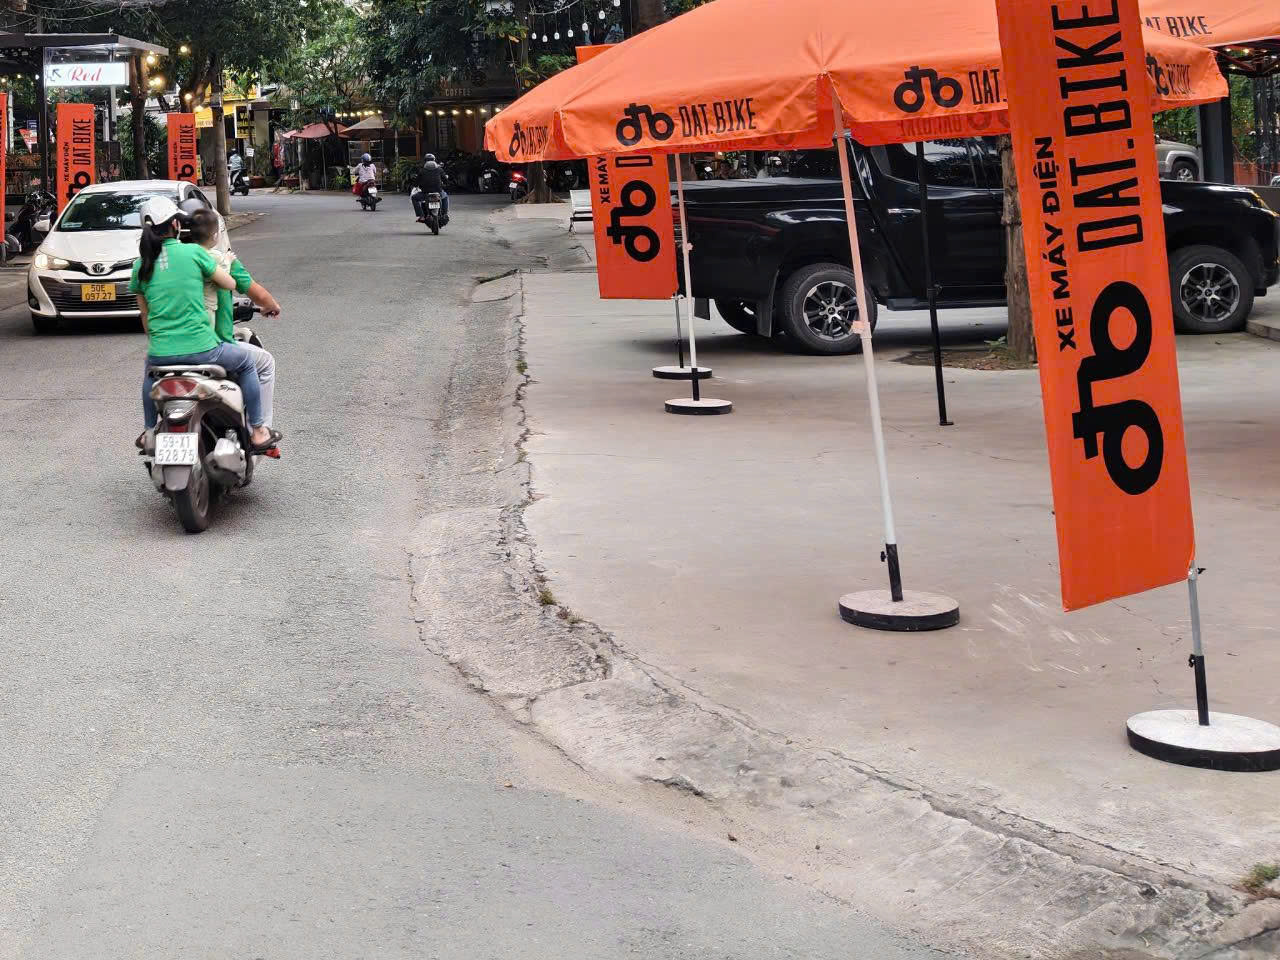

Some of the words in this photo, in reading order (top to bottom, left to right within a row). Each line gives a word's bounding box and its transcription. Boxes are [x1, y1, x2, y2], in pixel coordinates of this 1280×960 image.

[67, 65, 103, 82] Red
[678, 97, 757, 138] DAT.BIKE
[72, 118, 91, 166] DAT.BIKE
[600, 187, 611, 204] XE
[1032, 135, 1061, 217] ĐIỆN
[1042, 223, 1070, 300] MÁY
[90, 284, 106, 292] 50E
[1055, 306, 1077, 352] XE
